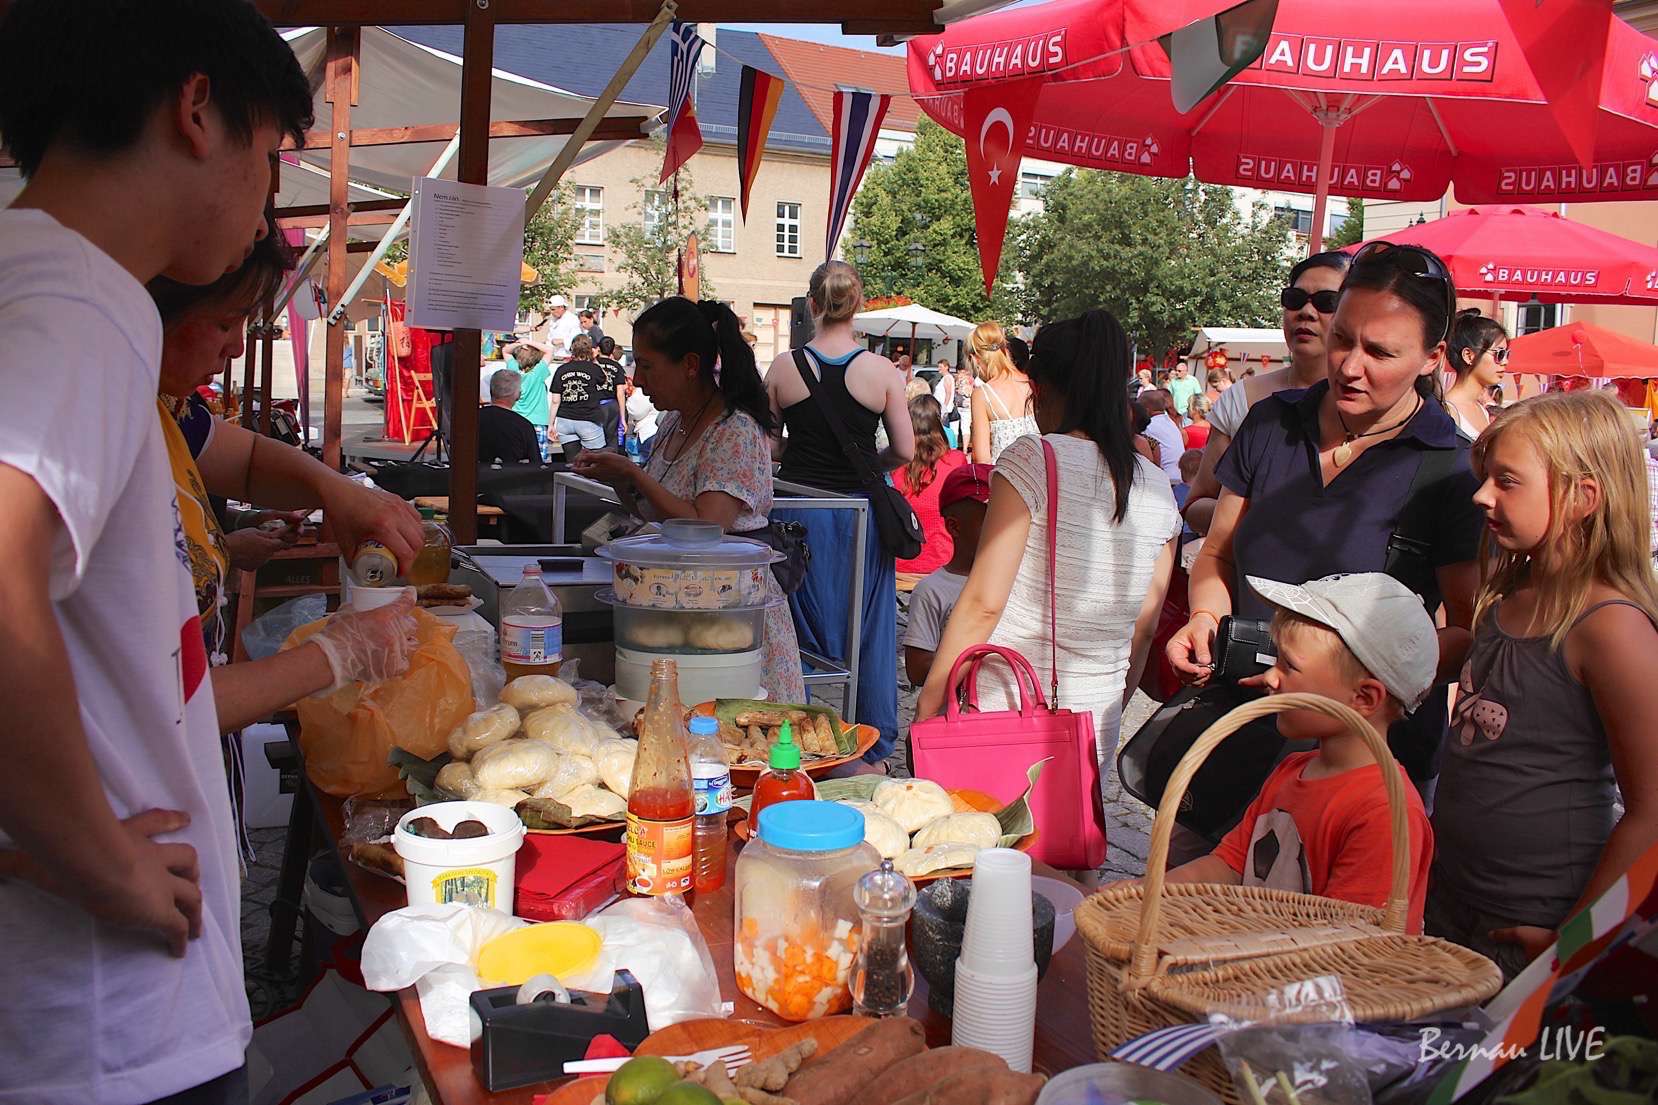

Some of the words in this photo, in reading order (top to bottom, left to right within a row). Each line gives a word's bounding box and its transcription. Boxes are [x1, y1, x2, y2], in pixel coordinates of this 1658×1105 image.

[945, 35, 1065, 77] BAUHAUS
[1498, 269, 1597, 285] BAUHAUS
[576, 371, 591, 381] WOO
